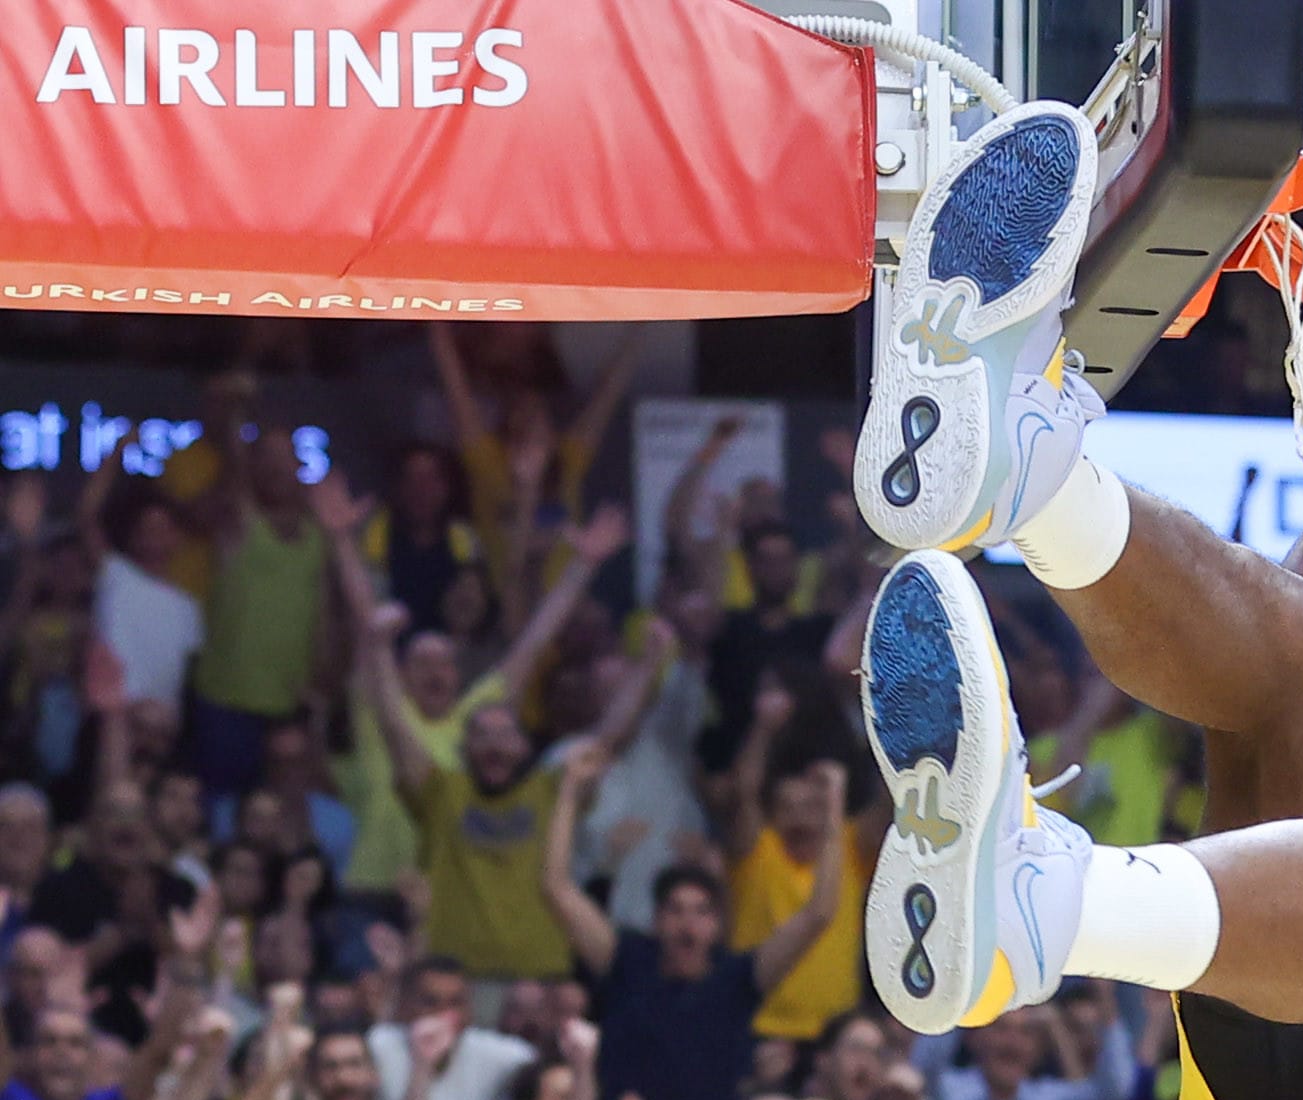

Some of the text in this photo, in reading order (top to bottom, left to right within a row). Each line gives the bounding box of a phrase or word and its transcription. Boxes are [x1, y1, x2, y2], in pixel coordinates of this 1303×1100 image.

[37, 26, 527, 108] AIRLINES
[3, 283, 524, 312] URKISH AIRLINES
